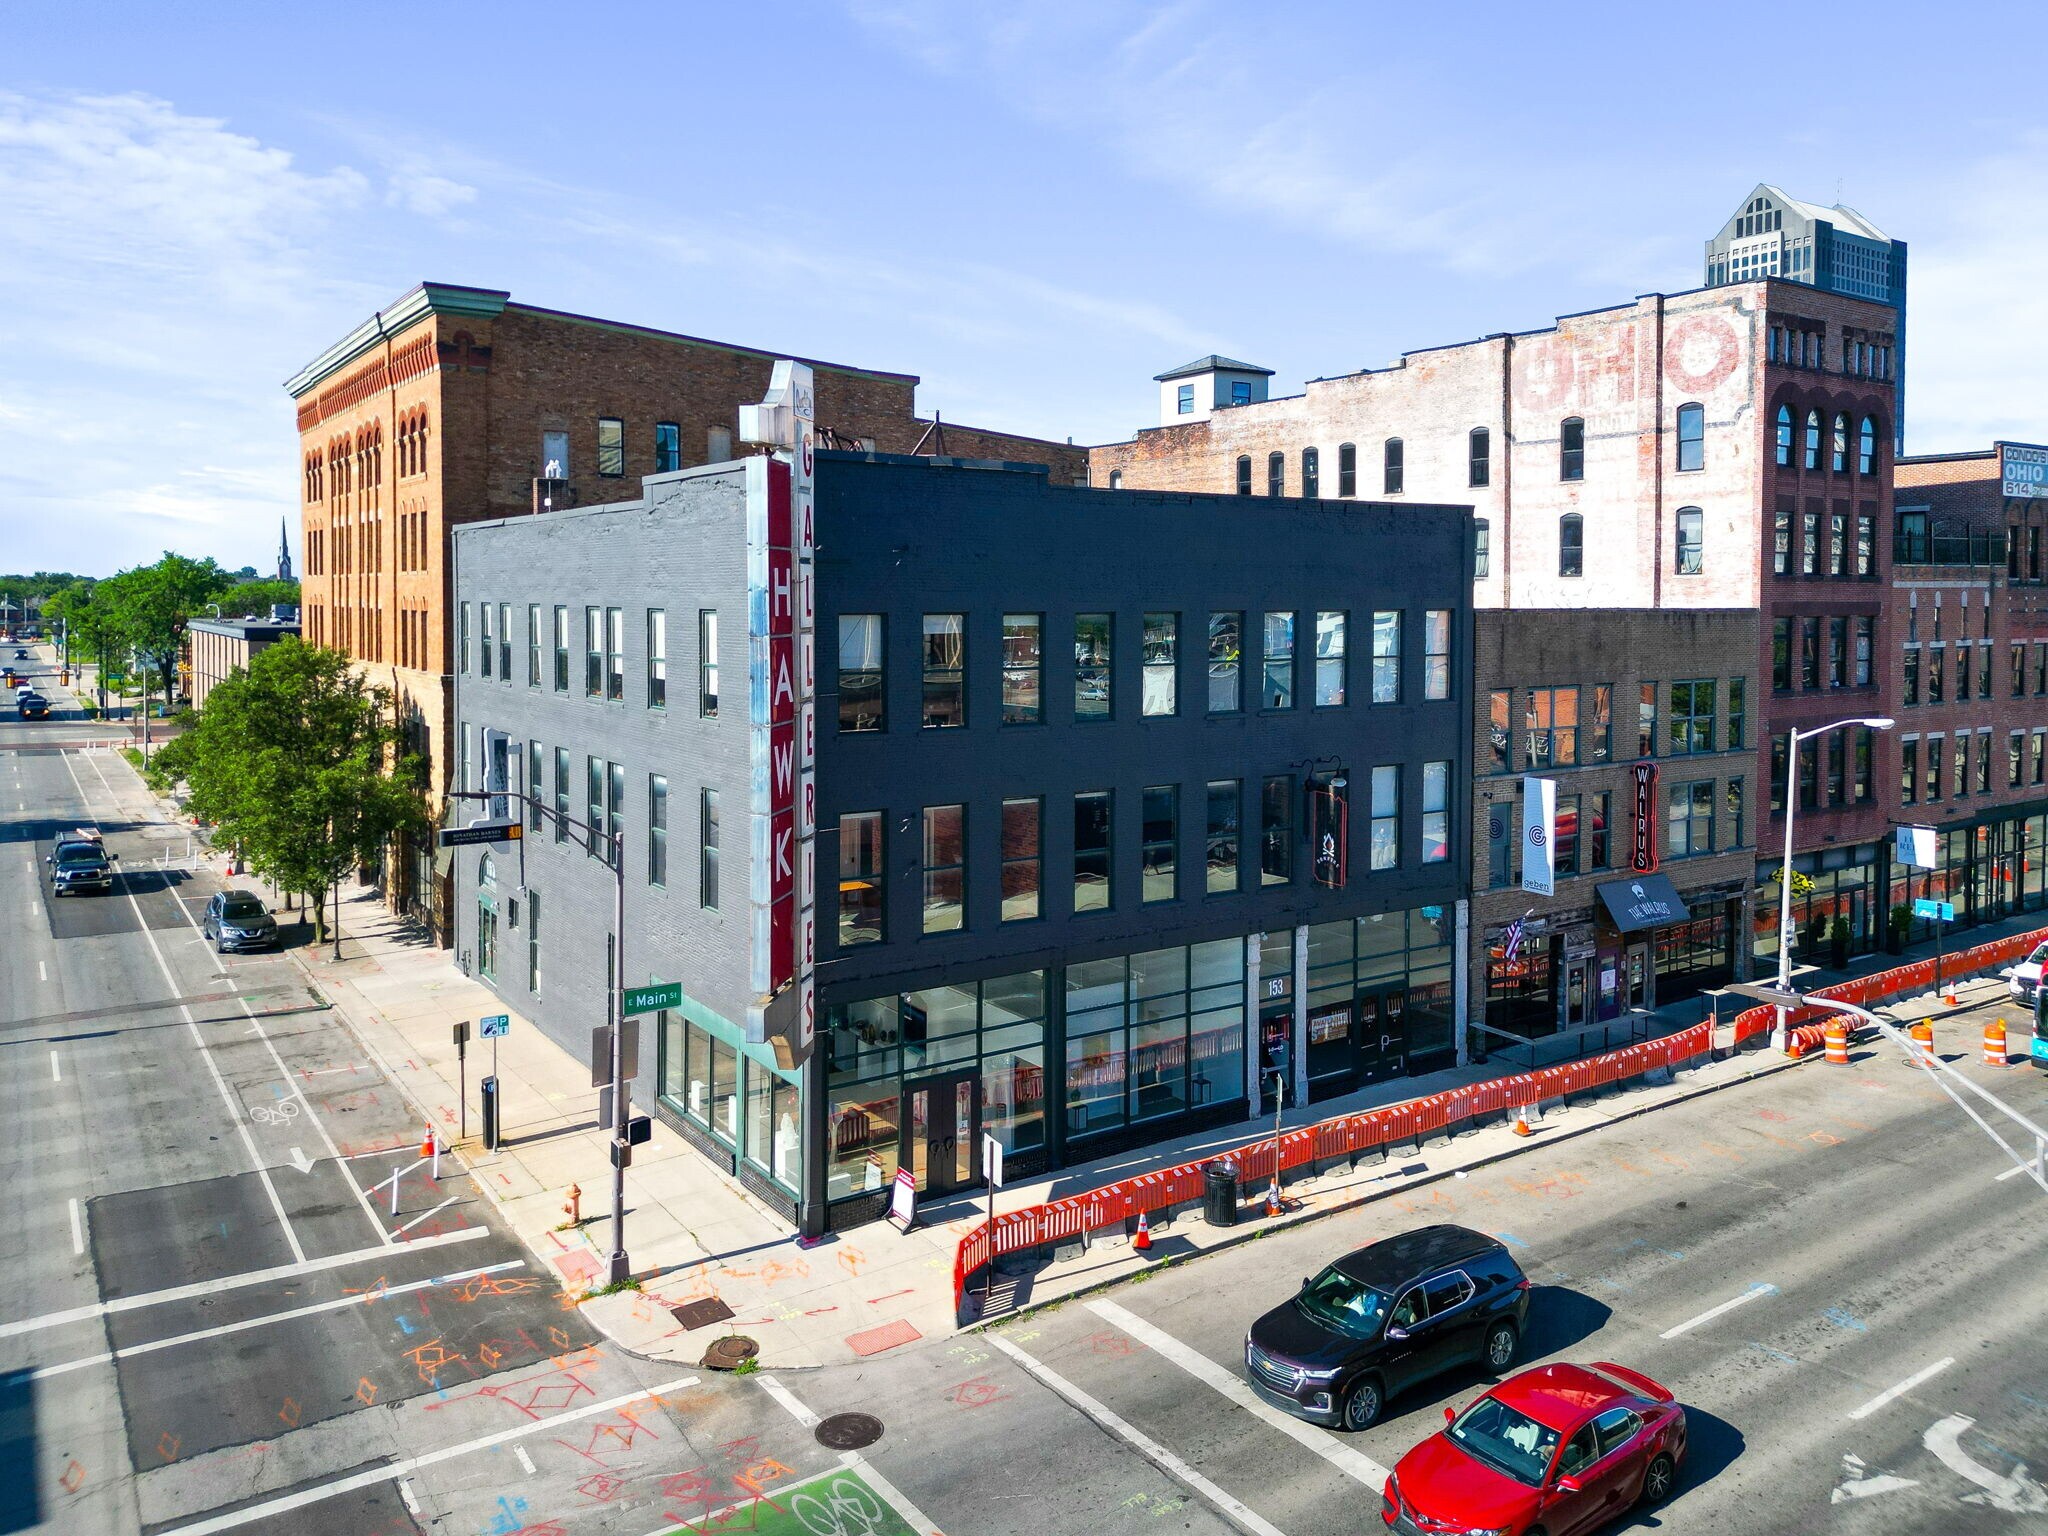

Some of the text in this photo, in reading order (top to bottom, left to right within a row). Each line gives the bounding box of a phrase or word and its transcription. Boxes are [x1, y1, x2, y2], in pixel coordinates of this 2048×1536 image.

[2005, 463, 2043, 482] OHIO
[772, 563, 794, 883] HAWK
[802, 433, 815, 1034] GALLERIES
[1637, 768, 1648, 867] WALRUS
[1523, 879, 1550, 891] geben
[1628, 904, 1645, 921] THE
[1639, 901, 1671, 915] WALRUS
[1268, 978, 1284, 996] 153
[628, 998, 633, 1006] E
[636, 992, 667, 1007] Main
